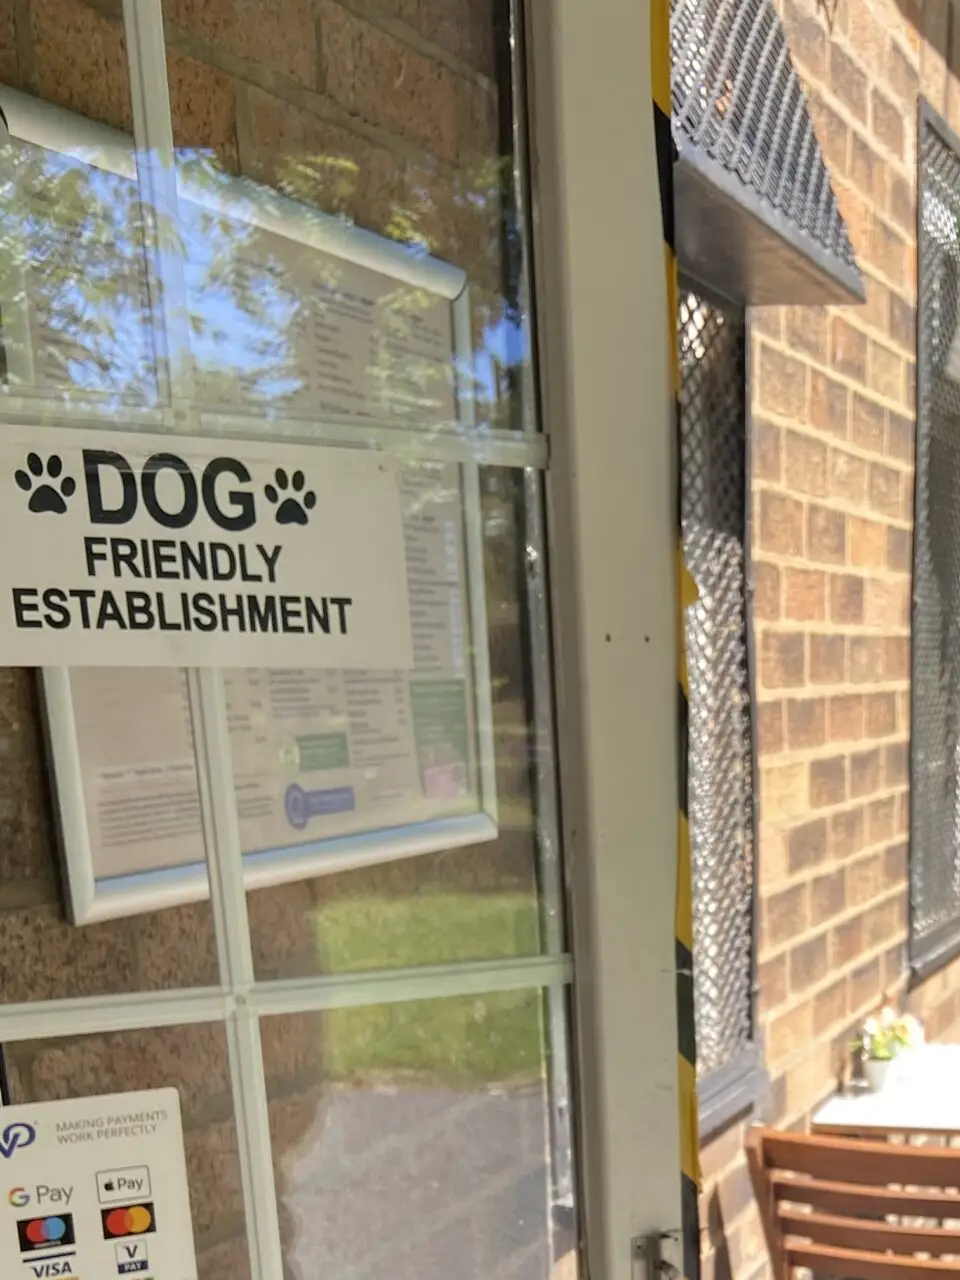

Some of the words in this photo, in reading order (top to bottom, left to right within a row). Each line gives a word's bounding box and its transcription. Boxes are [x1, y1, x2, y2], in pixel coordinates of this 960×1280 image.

[82, 448, 257, 531] DOG
[83, 536, 282, 582] FRIENDLY
[12, 588, 353, 634] ESTABLISHMENT
[56, 1117, 105, 1133] MAKING
[106, 1110, 168, 1127] PAYMENTS
[57, 1131, 95, 1145] WORK
[98, 1123, 158, 1139] PERFECTLY
[36, 1184, 74, 1206] Pay
[117, 1177, 144, 1191] Pay
[33, 1261, 73, 1279] VISA
